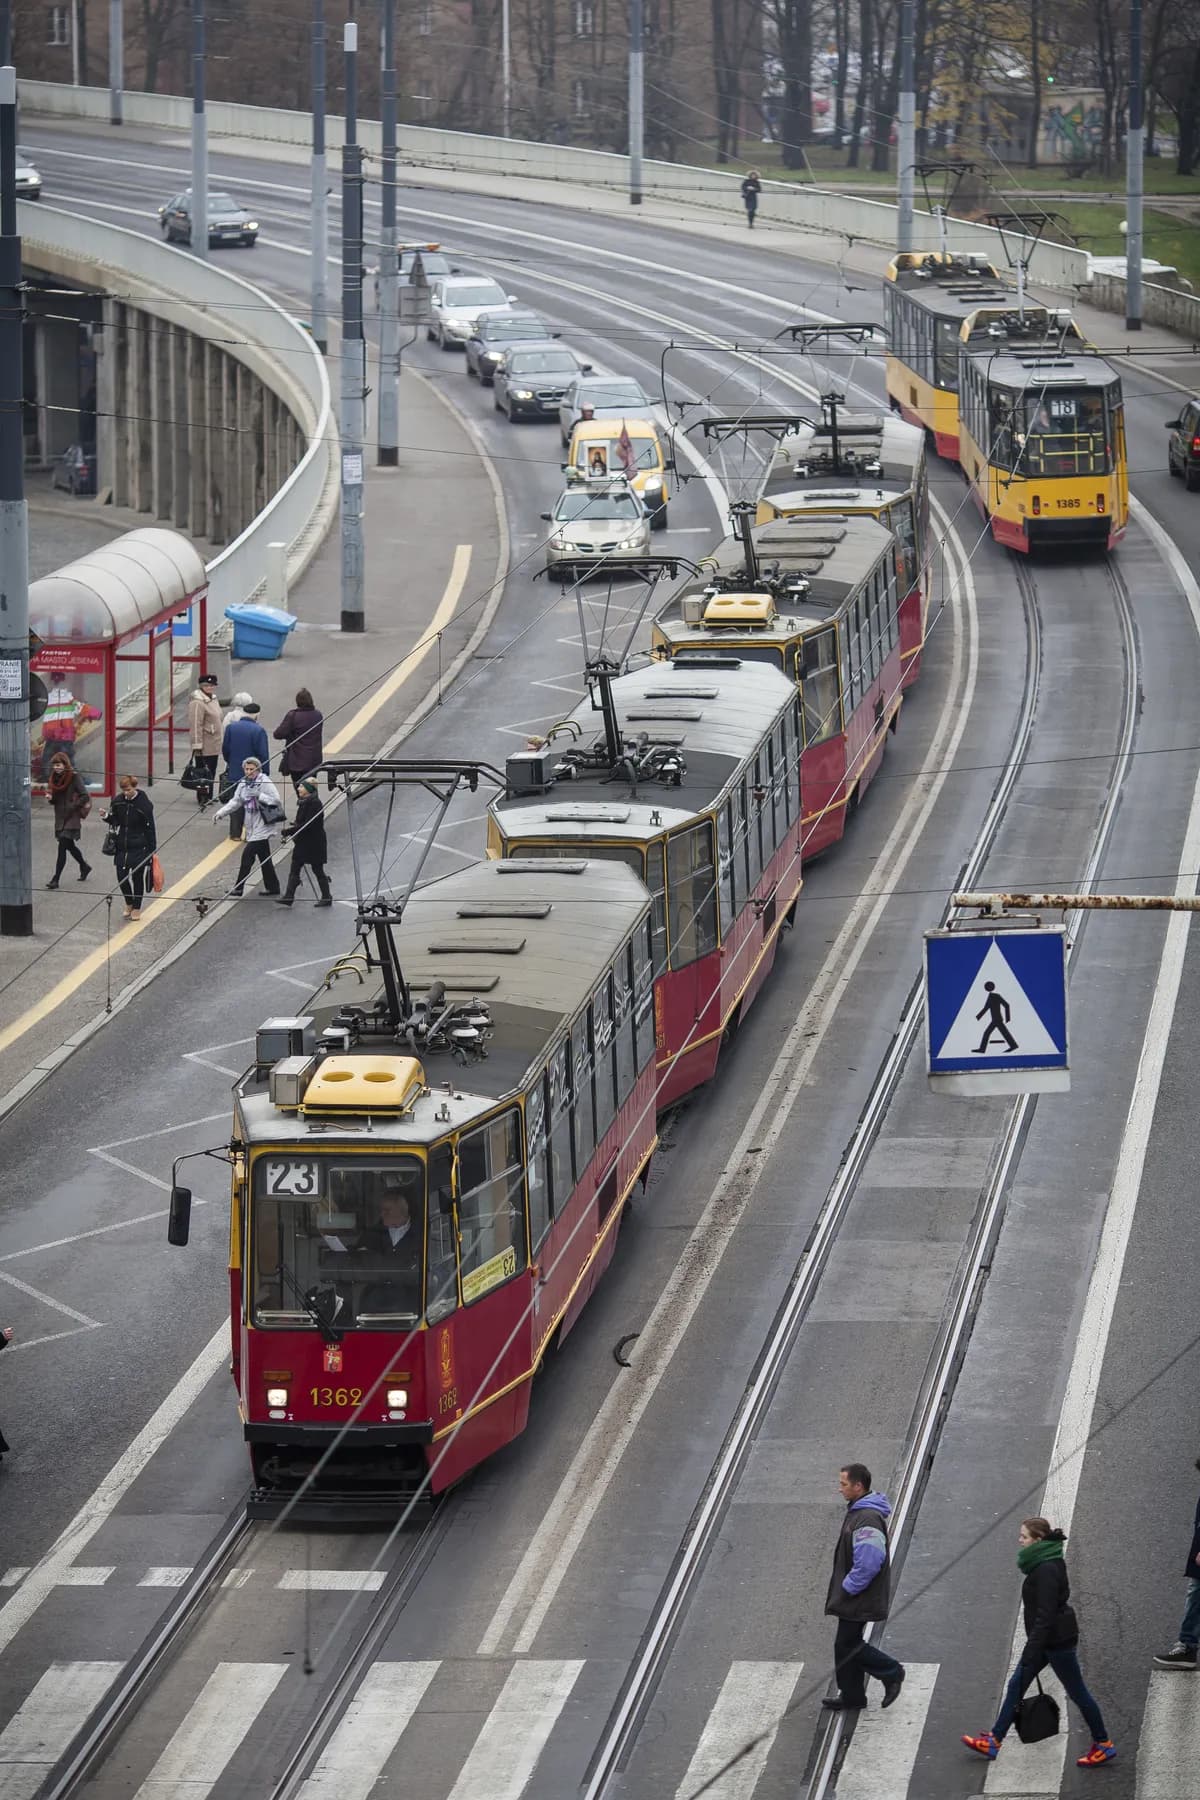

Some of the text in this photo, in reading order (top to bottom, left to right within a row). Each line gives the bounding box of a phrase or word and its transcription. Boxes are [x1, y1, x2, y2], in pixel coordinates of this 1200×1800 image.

[1053, 400, 1073, 414] 18
[1056, 499, 1080, 508] 1385
[271, 1160, 314, 1194] 23
[310, 1387, 363, 1406] 1362
[439, 1388, 457, 1414] 1362
